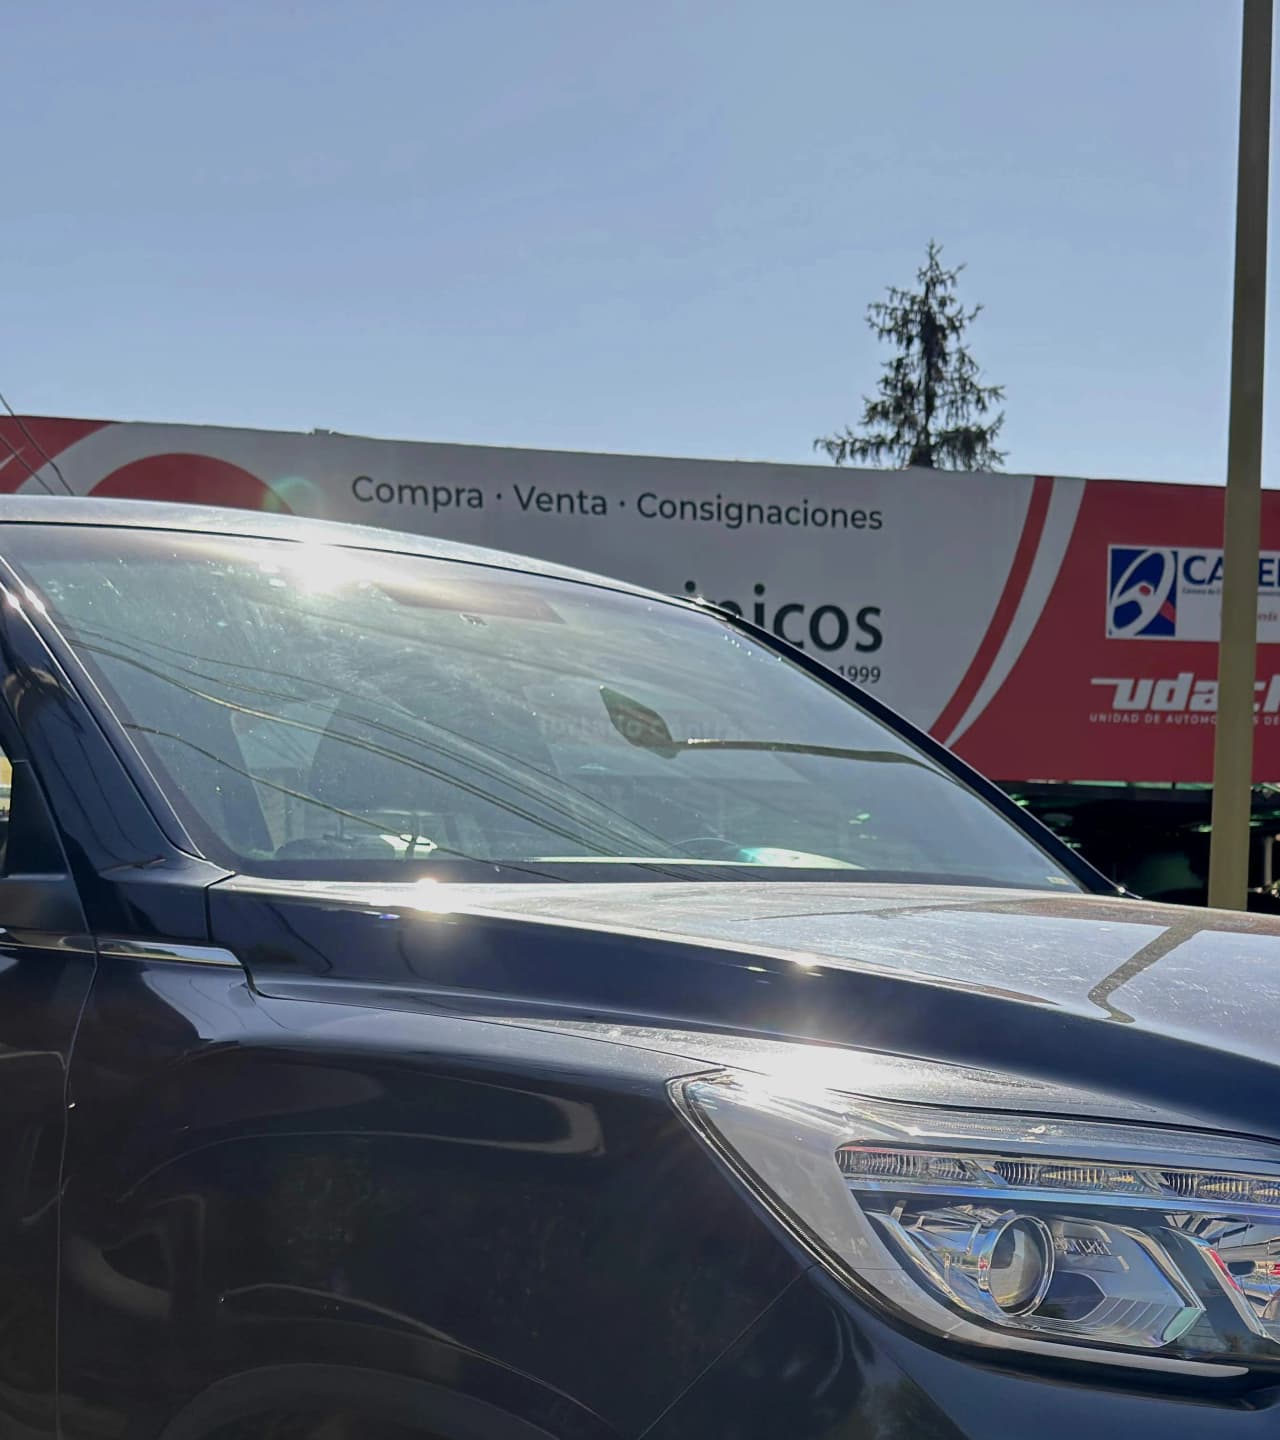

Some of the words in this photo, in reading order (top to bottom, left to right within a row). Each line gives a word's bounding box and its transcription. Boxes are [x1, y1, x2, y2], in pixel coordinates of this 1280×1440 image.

[352, 475, 484, 513] Compra
[514, 484, 607, 516] Venta
[637, 492, 883, 530] Consignaciones
[1089, 713, 1139, 724] UNIDAD
[1144, 714, 1160, 724] DE
